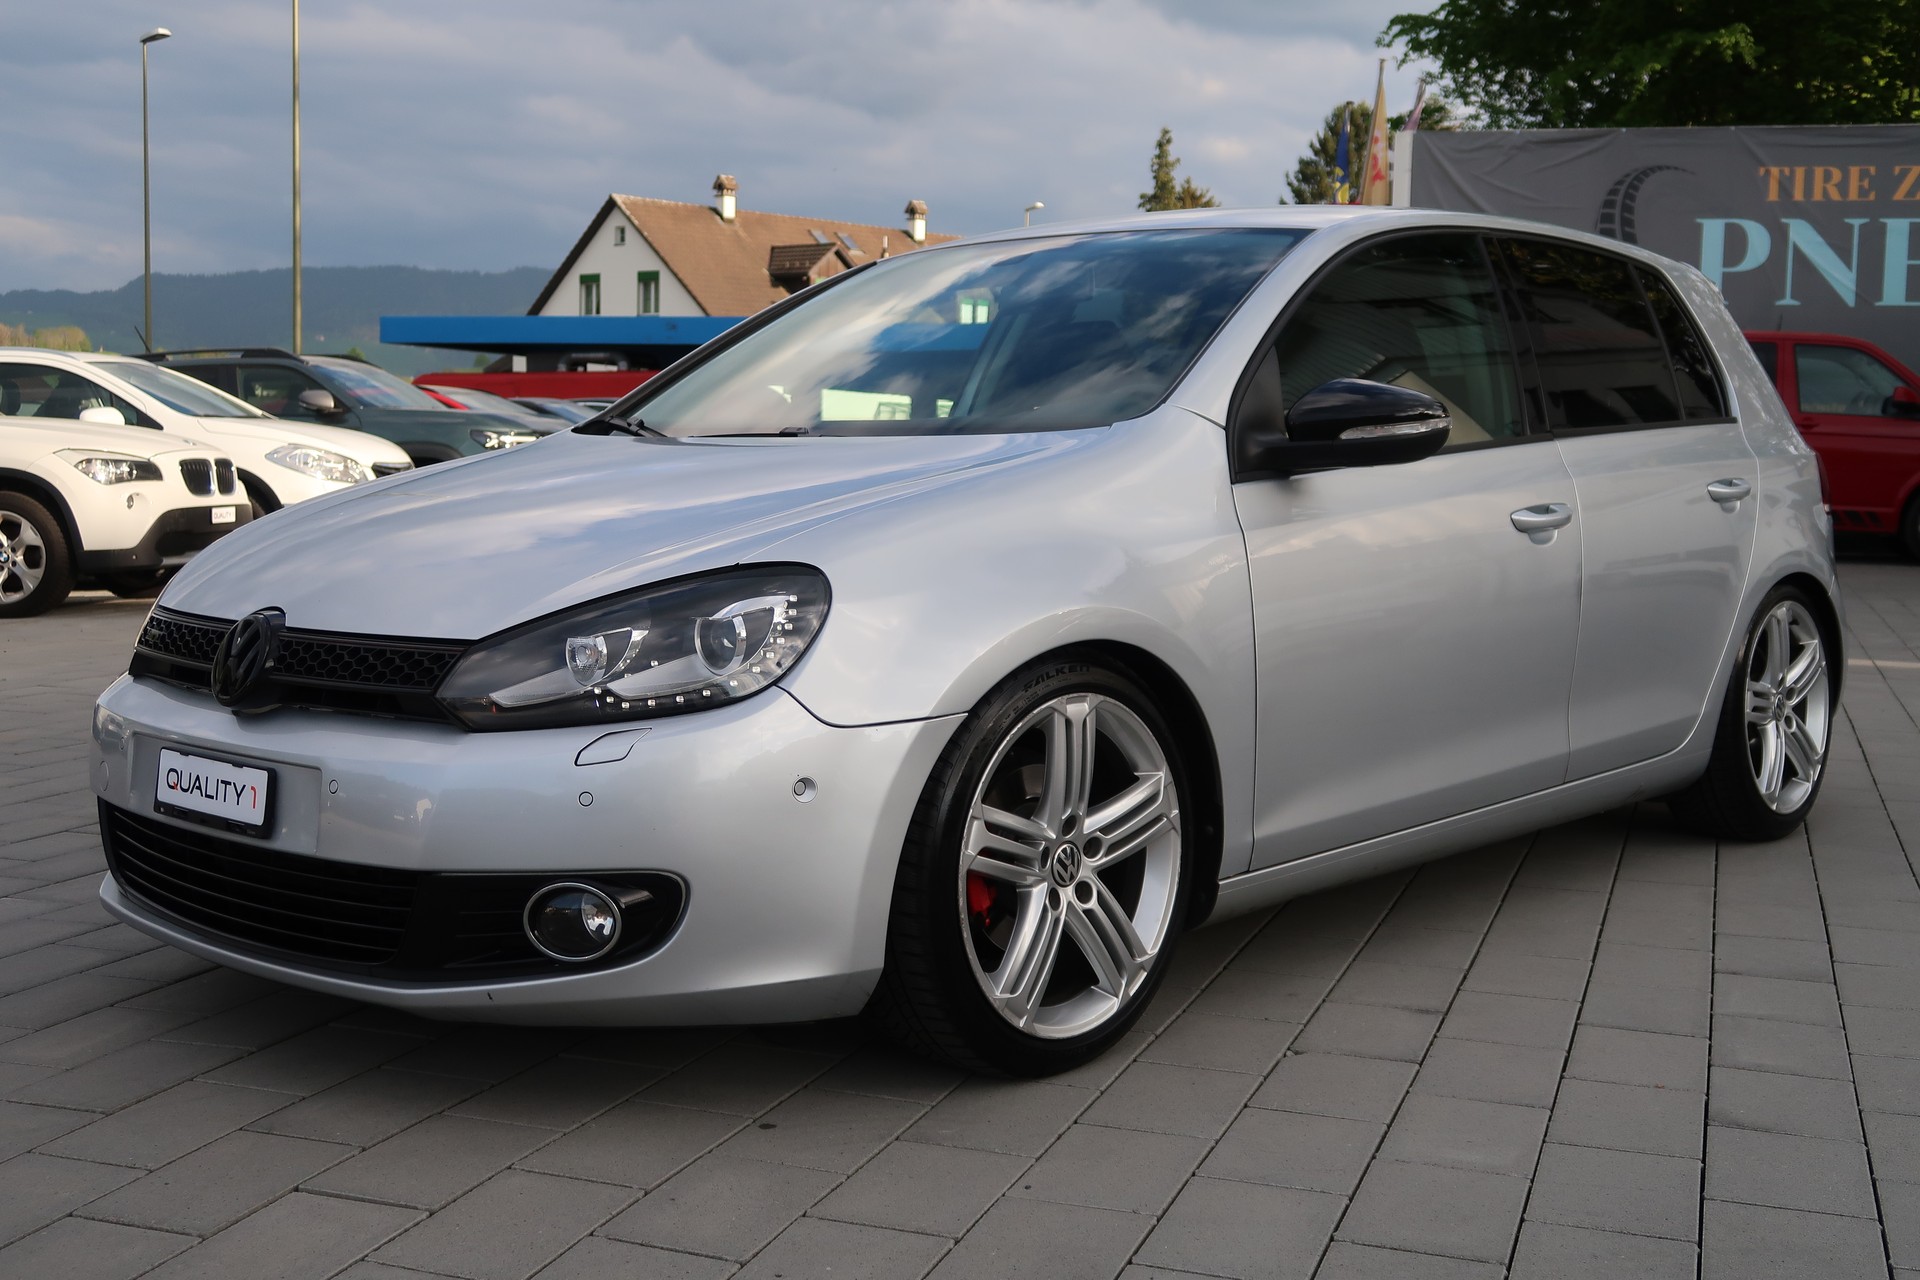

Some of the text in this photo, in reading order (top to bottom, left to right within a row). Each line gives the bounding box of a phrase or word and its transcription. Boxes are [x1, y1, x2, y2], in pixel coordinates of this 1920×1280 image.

[1759, 166, 1876, 201] TIRE
[166, 767, 257, 809] QUALITY 1
